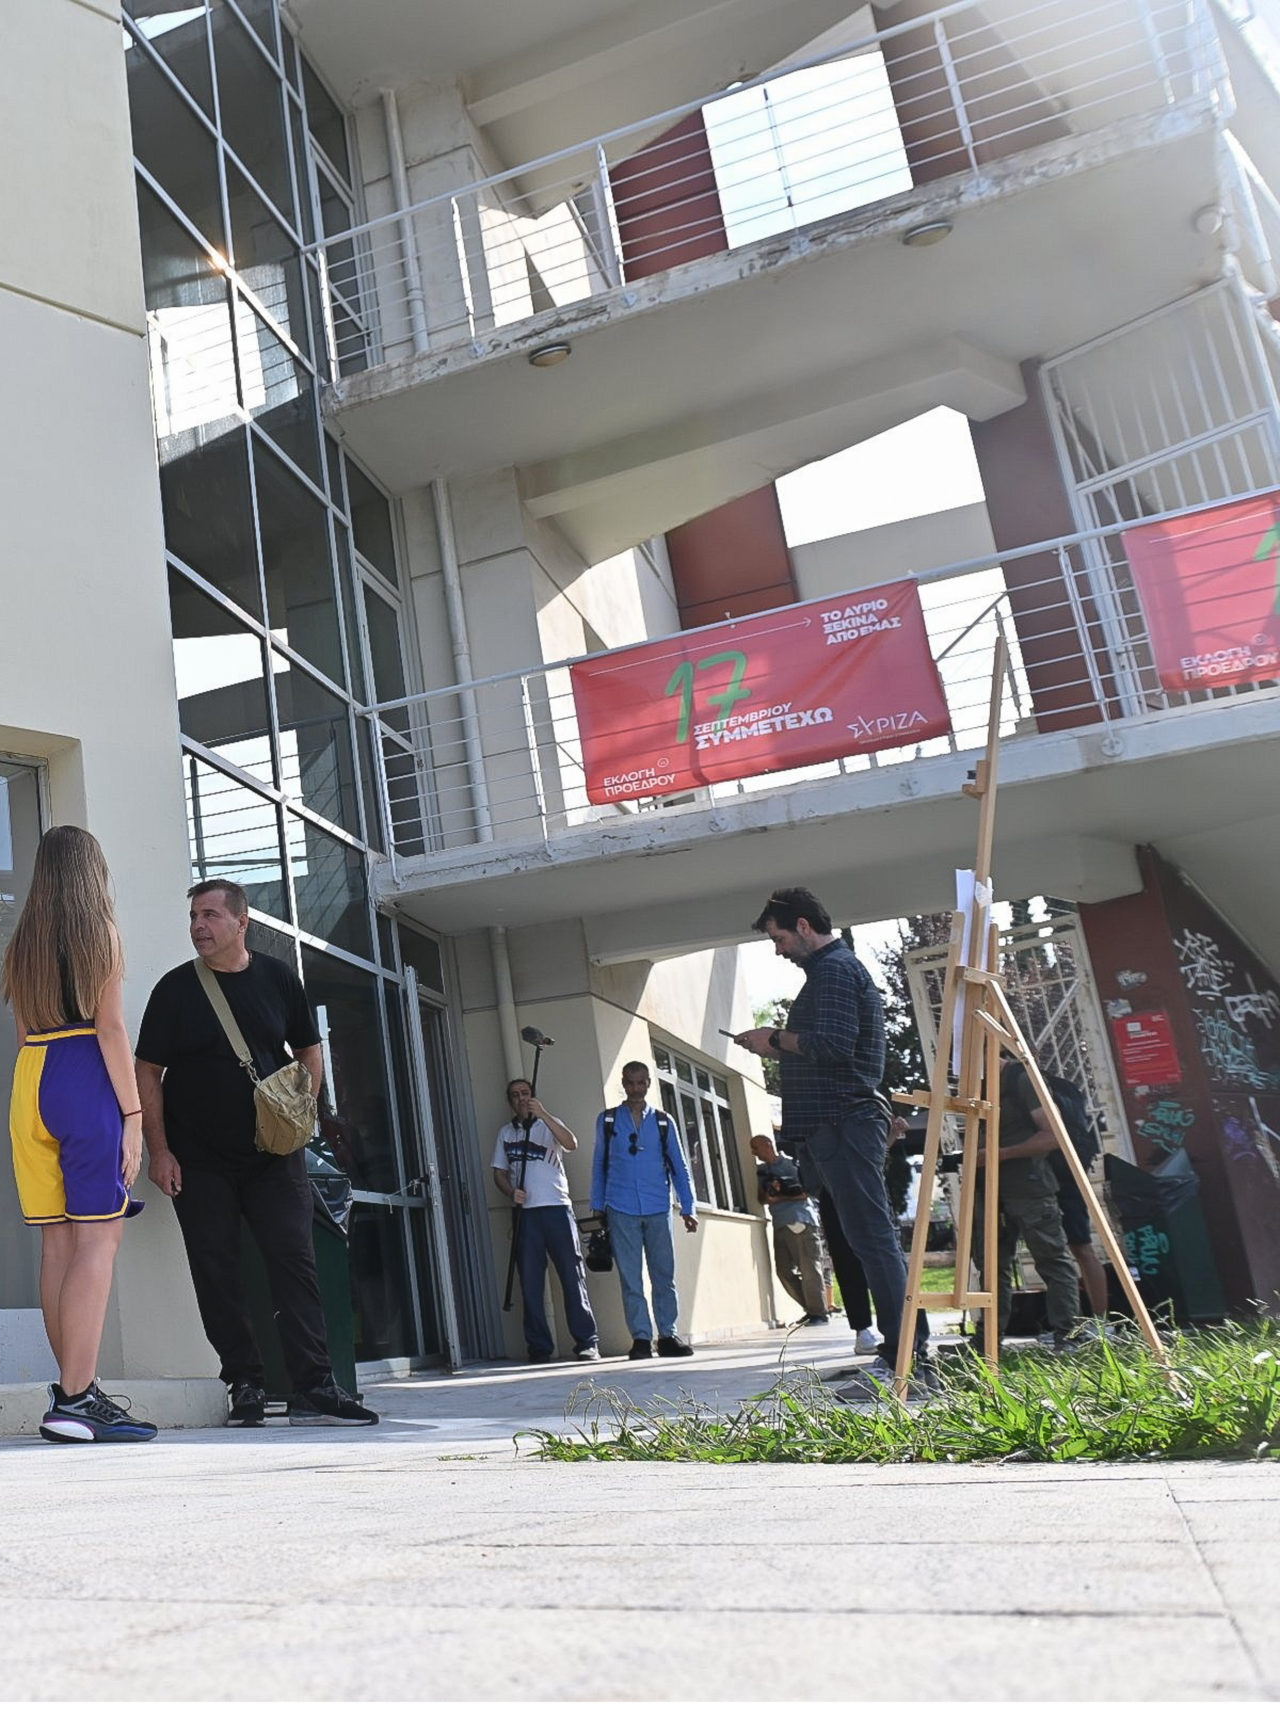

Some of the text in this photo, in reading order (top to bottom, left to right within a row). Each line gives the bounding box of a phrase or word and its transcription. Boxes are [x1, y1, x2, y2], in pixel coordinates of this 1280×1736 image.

[821, 599, 888, 622] ΤΟ ΑΥΡΙΟ
[823, 613, 878, 634] ΞΕΚΙΝΑ
[826, 616, 902, 645] ΑΠΟ ΕΜΑΣ
[1181, 646, 1251, 668] ΕΚΛΟΓΗ
[1183, 652, 1279, 681] ΠΡΟΕΔΡΟΥ
[667, 650, 752, 743] 17
[694, 703, 792, 735] ΣΕΠΤΕΜΒΡΙΟΥ
[696, 706, 833, 750] ΣΥΜΜΕΤΕΧΩ
[603, 767, 655, 787] ΕΚΛΟΓΗ
[604, 773, 676, 797] ΠΡΟΕΔΡΟΥ
